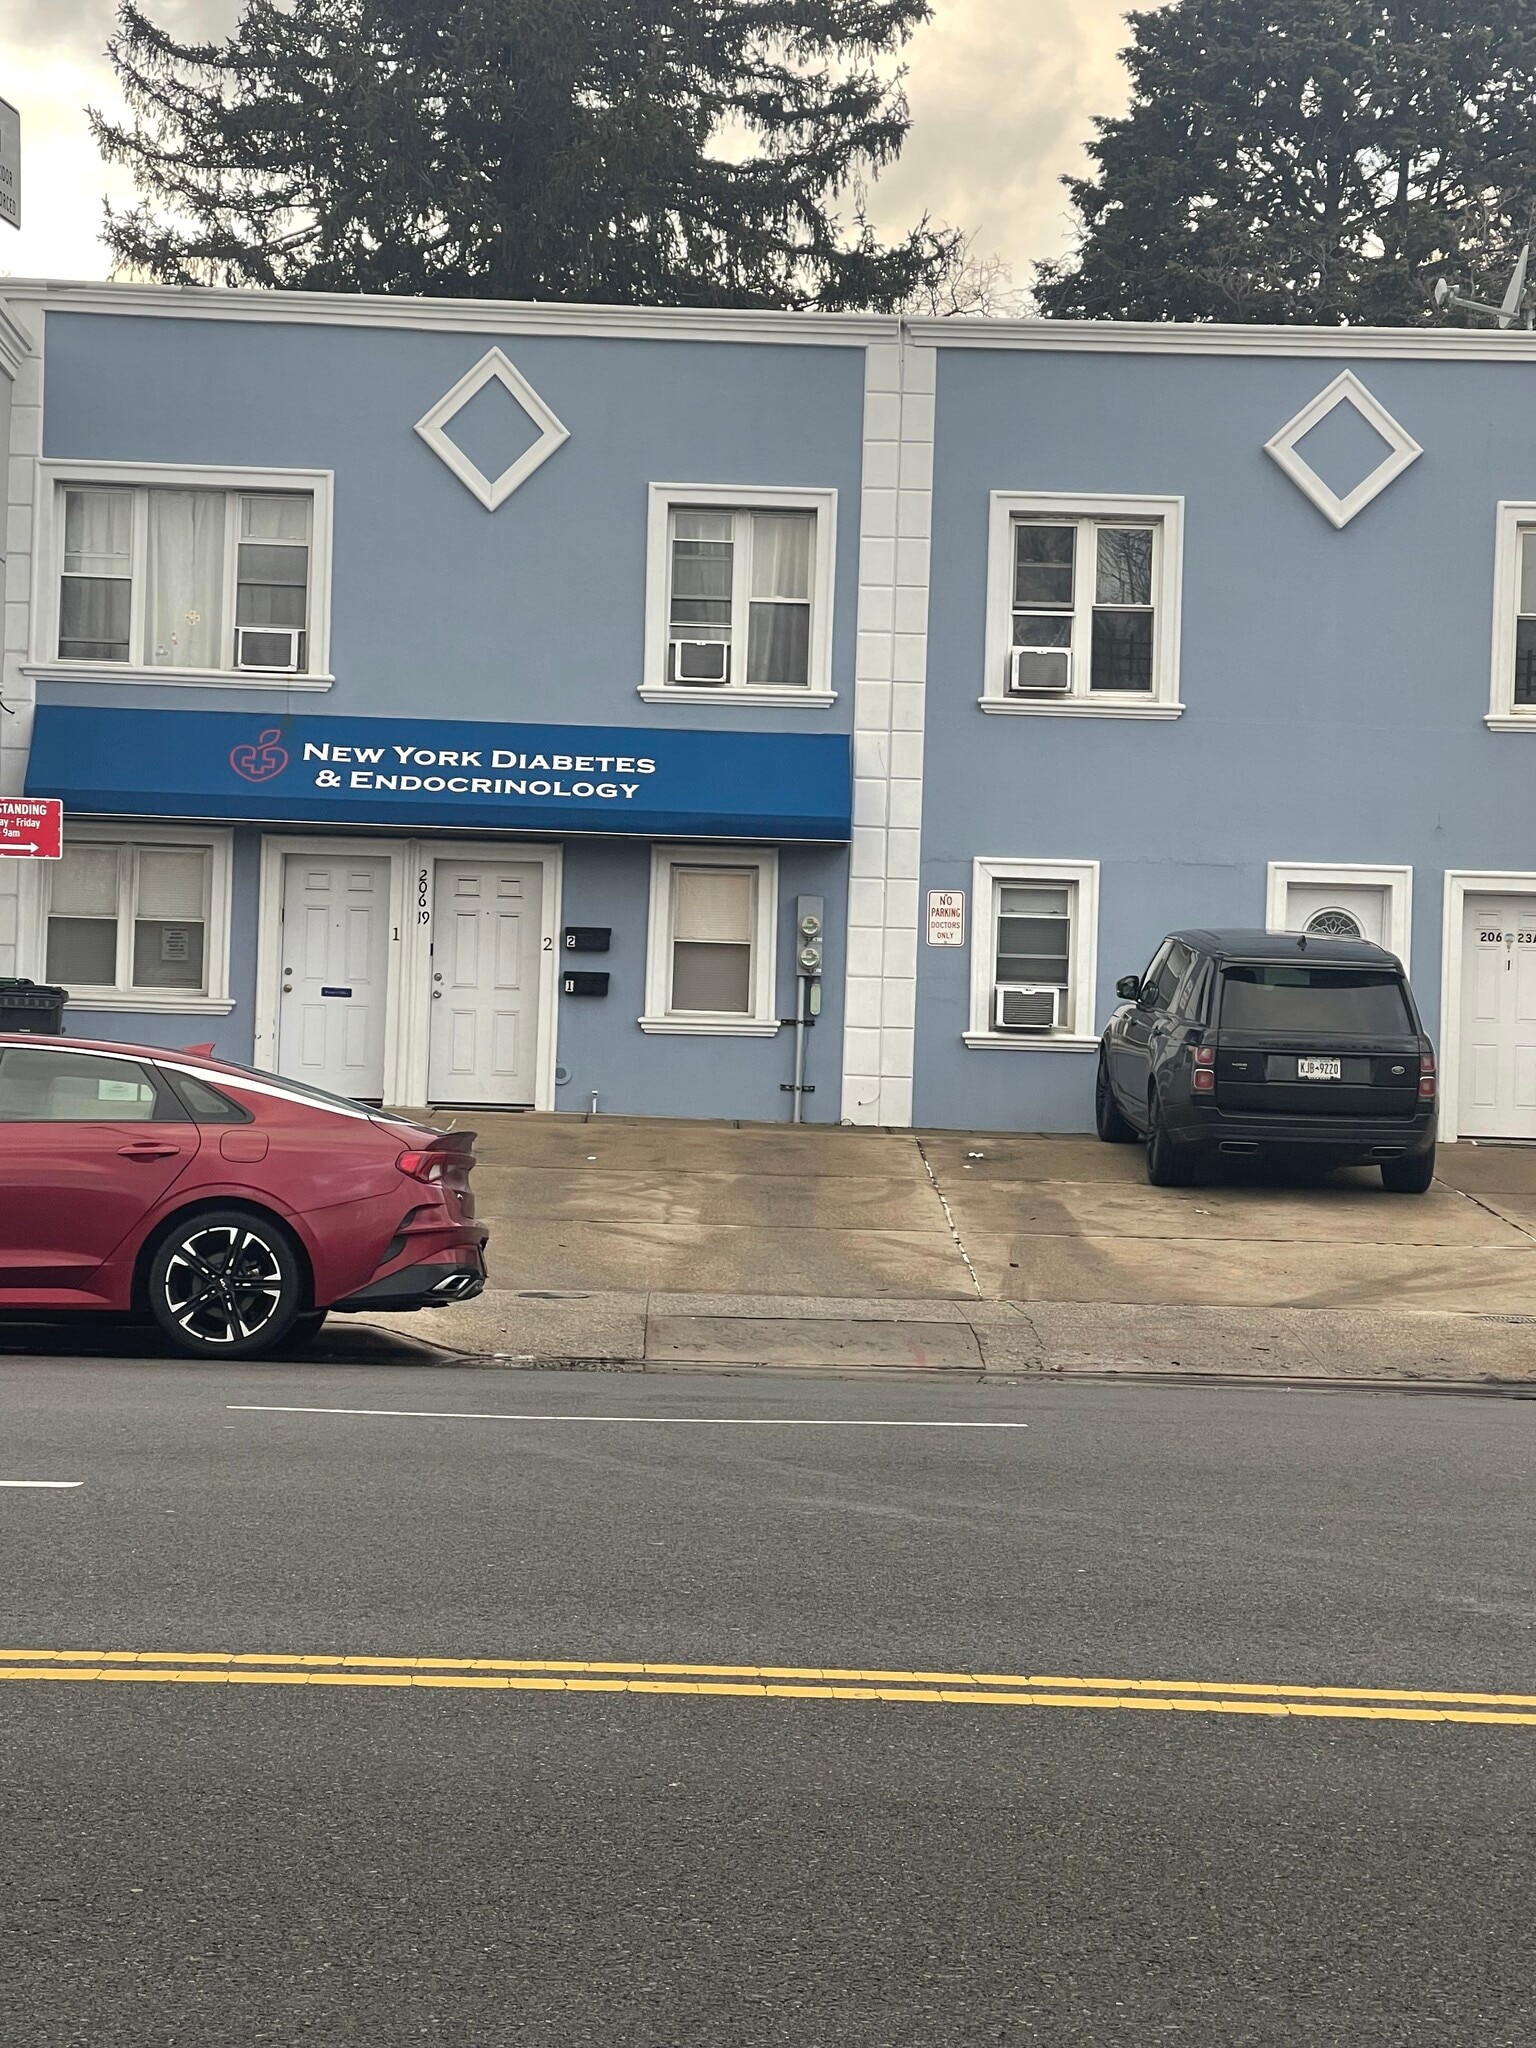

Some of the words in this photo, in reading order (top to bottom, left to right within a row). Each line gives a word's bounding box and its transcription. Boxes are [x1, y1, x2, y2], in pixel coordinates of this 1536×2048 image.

[303, 742, 385, 764] NEW
[392, 745, 483, 768] YORK
[491, 750, 656, 774] DIABETES
[314, 769, 341, 788] &
[349, 771, 640, 799] ENDOCRINOLOGY
[16, 818, 41, 829] Friday
[2, 828, 21, 837] 9am
[939, 896, 953, 906] NO
[931, 907, 961, 917] PARKING
[930, 921, 961, 929] DOCTORS
[392, 927, 400, 941] 1
[936, 931, 954, 940] ONLY
[1480, 931, 1503, 942] 206
[543, 937, 553, 951] 2
[567, 936, 575, 946] 2
[566, 981, 574, 991] 1
